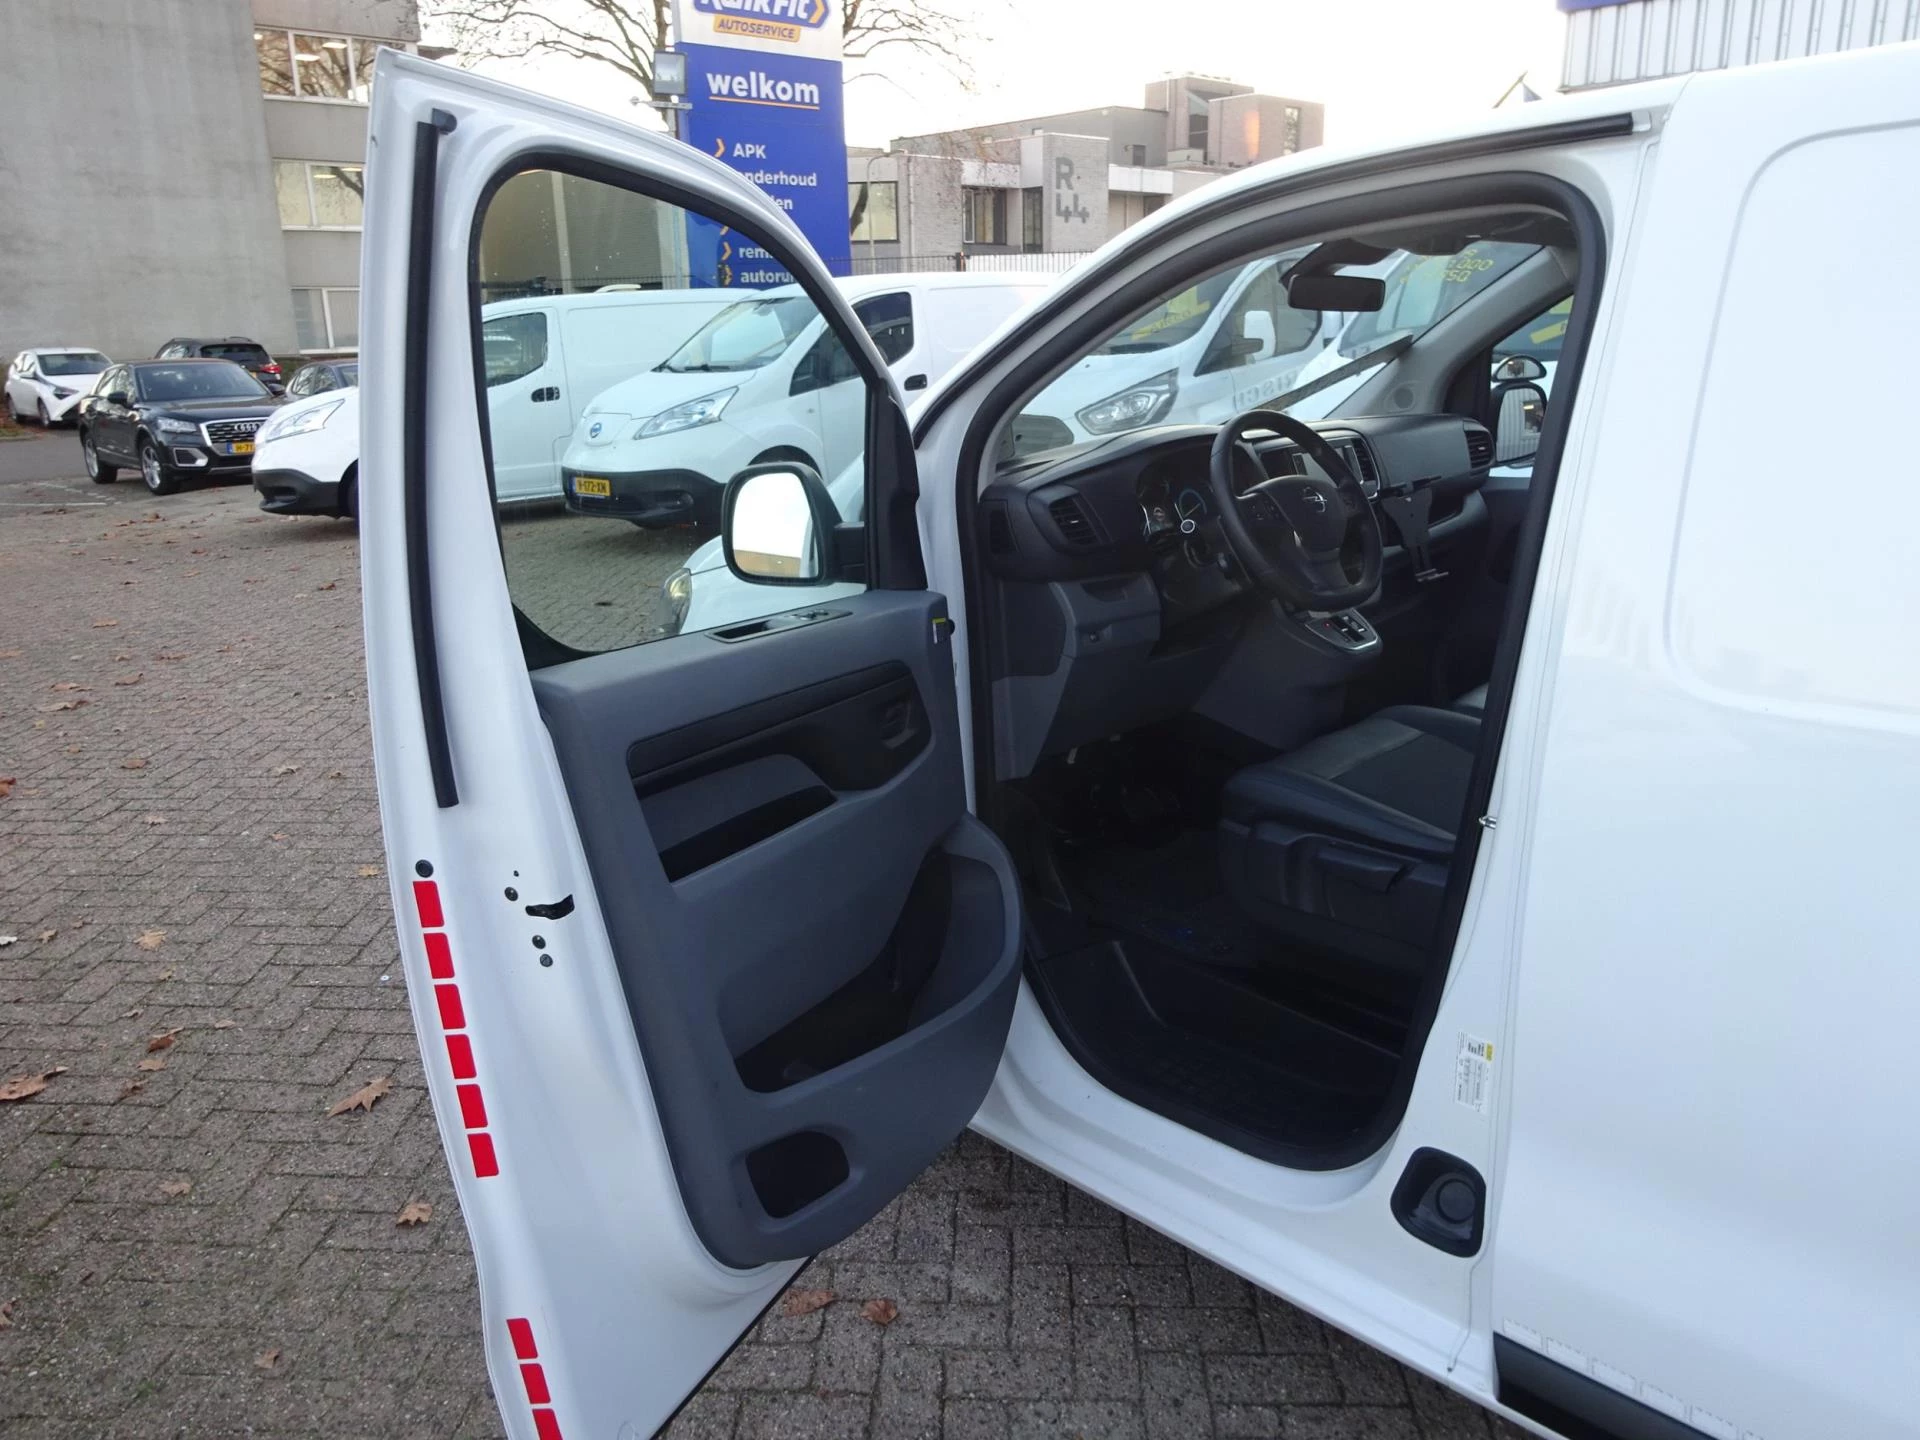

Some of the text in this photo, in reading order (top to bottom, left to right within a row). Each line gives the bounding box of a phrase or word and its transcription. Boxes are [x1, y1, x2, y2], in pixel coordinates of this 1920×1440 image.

[718, 19, 795, 39] AUTOSERVICE
[706, 71, 819, 104] welkom
[733, 143, 766, 159] APK
[744, 170, 817, 187] nderhoud
[1056, 157, 1074, 191] R
[739, 247, 773, 259] rem
